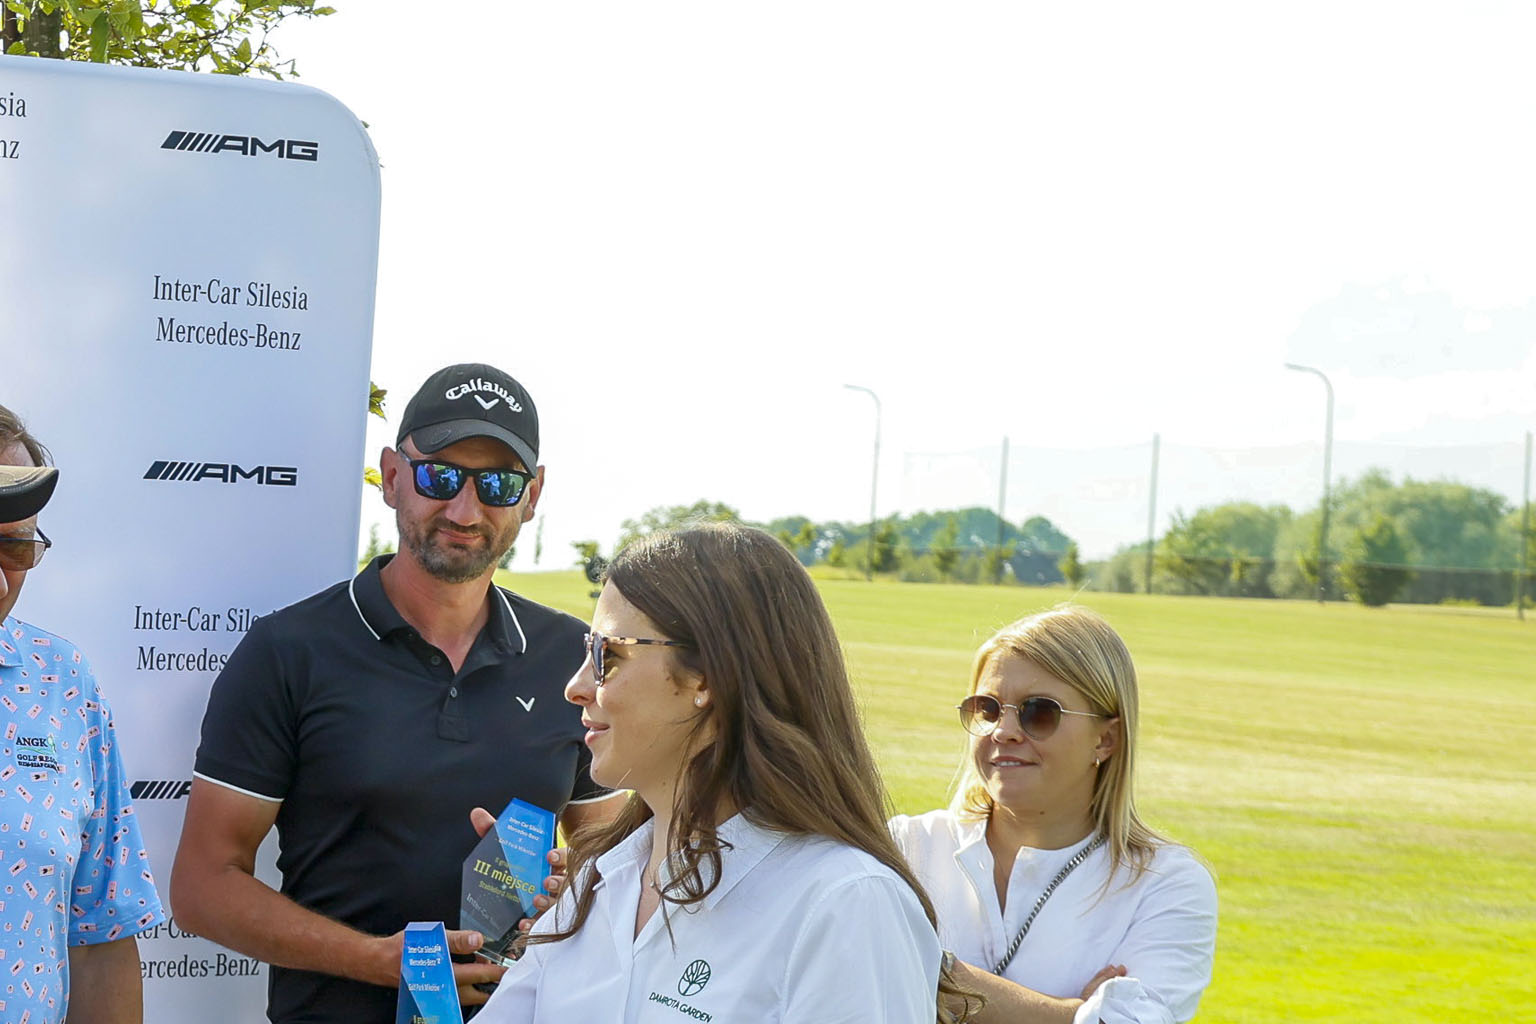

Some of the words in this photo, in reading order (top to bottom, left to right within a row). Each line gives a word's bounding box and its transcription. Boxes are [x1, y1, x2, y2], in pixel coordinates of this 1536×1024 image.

[214, 134, 318, 162] AMG
[153, 276, 241, 304] Inter-Car
[247, 282, 307, 310] Silesia
[156, 317, 300, 350] Mercedes-Benz
[445, 378, 522, 413] Callaway
[198, 463, 297, 486] AMG
[134, 606, 220, 631] Inter-Car
[137, 646, 227, 672] Mercedes
[16, 736, 48, 747] ANGK
[474, 860, 491, 876] III
[491, 869, 536, 894] miejsce
[141, 952, 260, 979] ercedes-Benz
[679, 1003, 713, 1023] GARDEN
